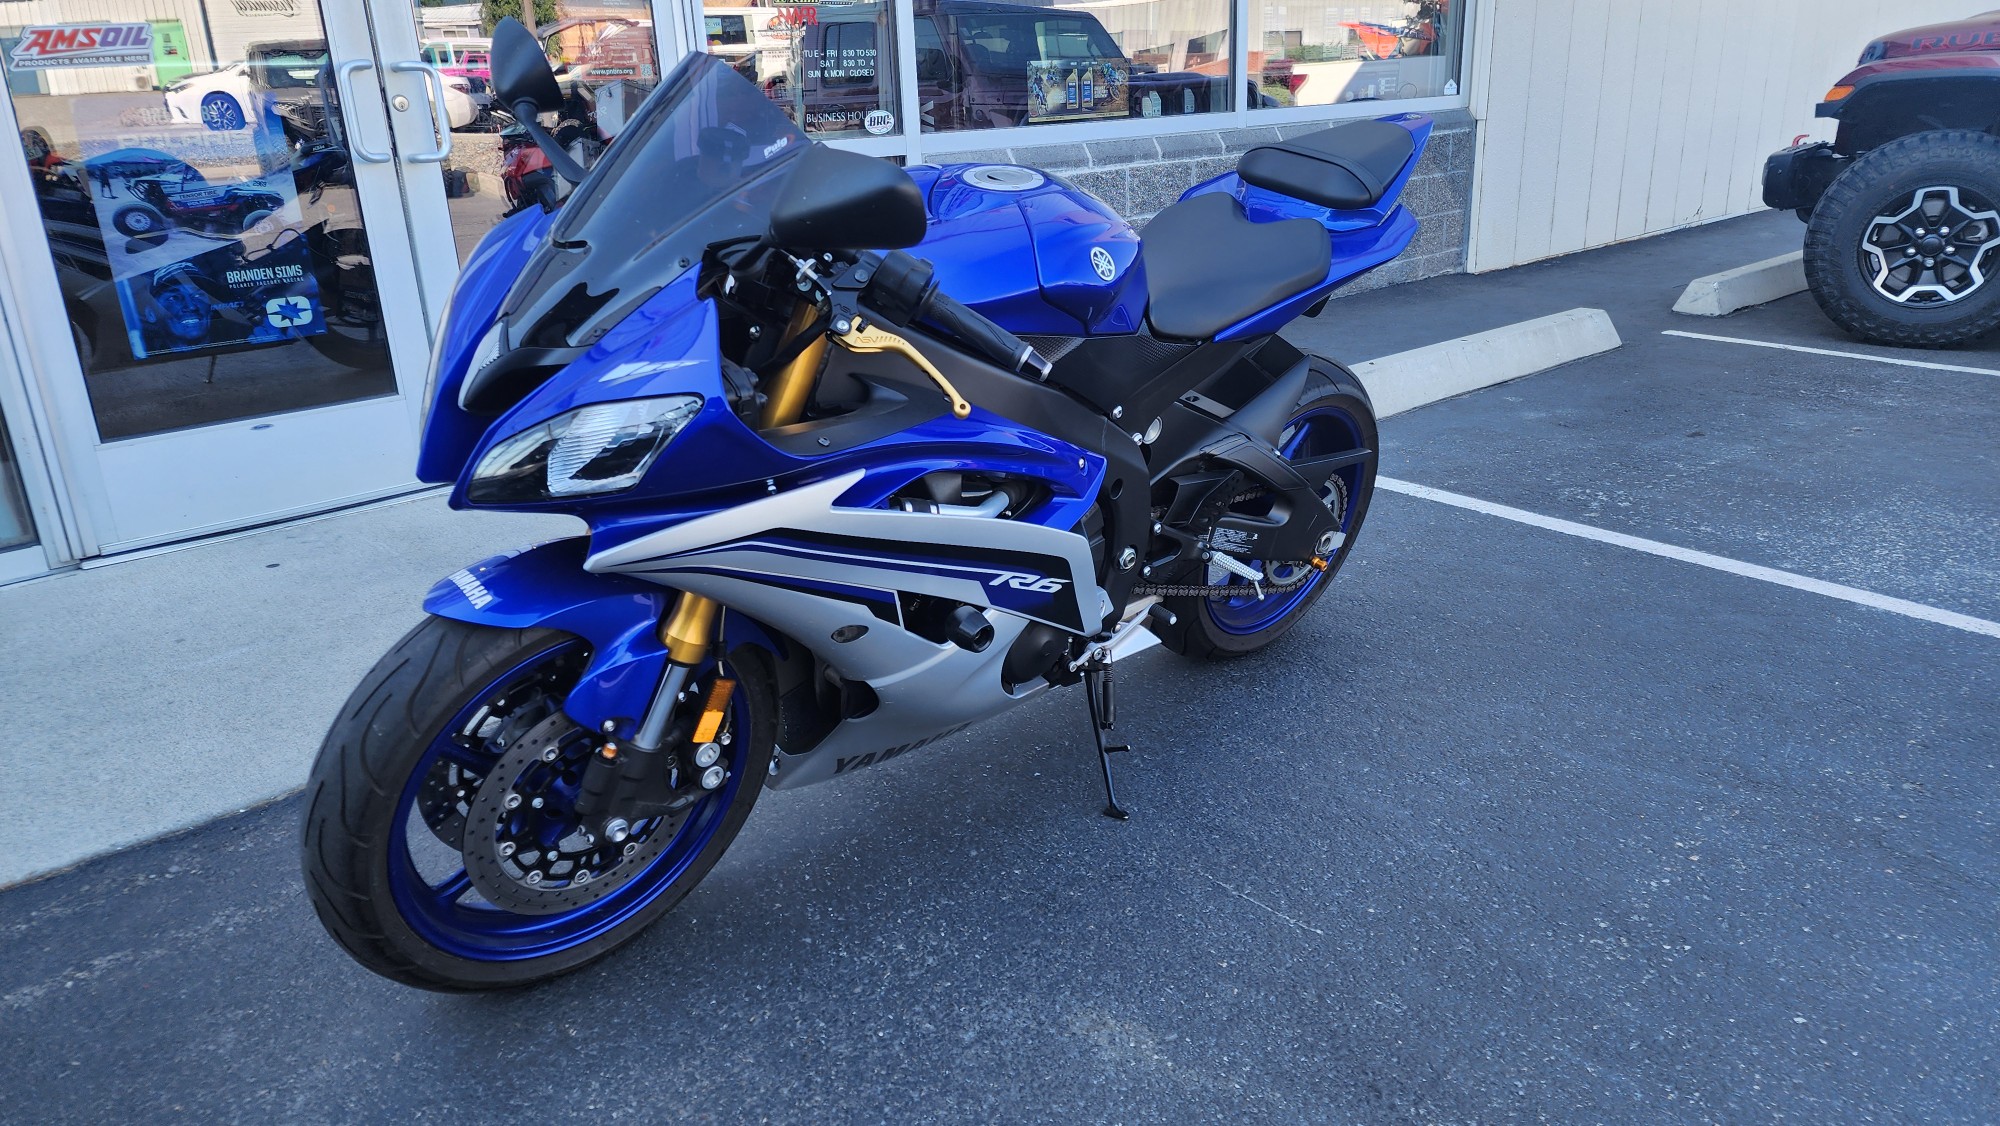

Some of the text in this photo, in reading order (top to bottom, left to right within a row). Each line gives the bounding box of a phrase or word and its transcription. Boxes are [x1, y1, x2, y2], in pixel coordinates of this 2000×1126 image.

[22, 26, 149, 55] AMSOIL
[18, 58, 70, 67] PRODUCTS
[71, 56, 122, 64] AVAILABLE
[807, 70, 820, 78] SUN
[806, 109, 874, 123] BUSINESS HOU
[763, 137, 788, 156] Puig
[226, 264, 303, 284] BRANDEN SIMS
[988, 570, 1072, 593] R6
